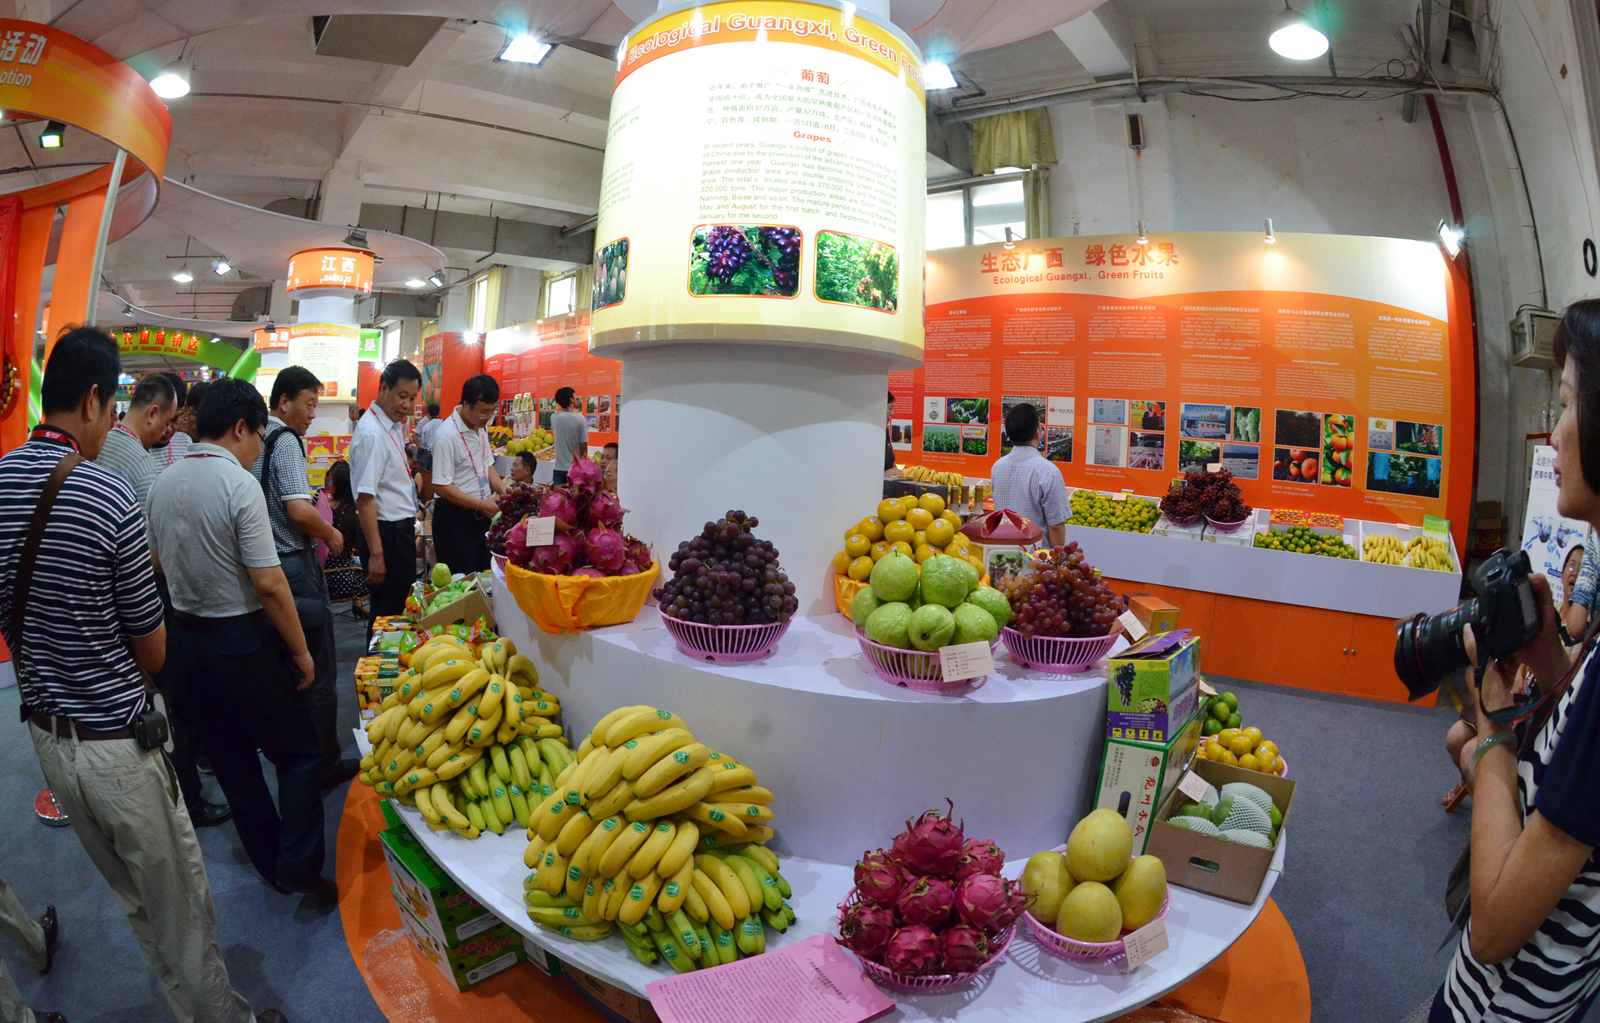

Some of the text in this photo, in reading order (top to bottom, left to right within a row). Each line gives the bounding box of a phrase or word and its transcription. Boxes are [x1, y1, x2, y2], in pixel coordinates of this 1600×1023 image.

[627, 15, 720, 65] Ecological
[727, 12, 837, 42] Guangxi,
[842, 25, 898, 64] Green
[801, 68, 831, 85] 葡萄
[793, 130, 832, 143] Grapes
[818, 165, 843, 174] become
[825, 158, 853, 168] advanced
[802, 171, 824, 179] double
[793, 196, 805, 204] The
[321, 255, 357, 273] 江西
[981, 242, 1180, 273] 生态广西 绿色水果
[993, 269, 1164, 284] Ecological Guangxi, Green Fruits
[109, 331, 200, 351] 农垦展销区
